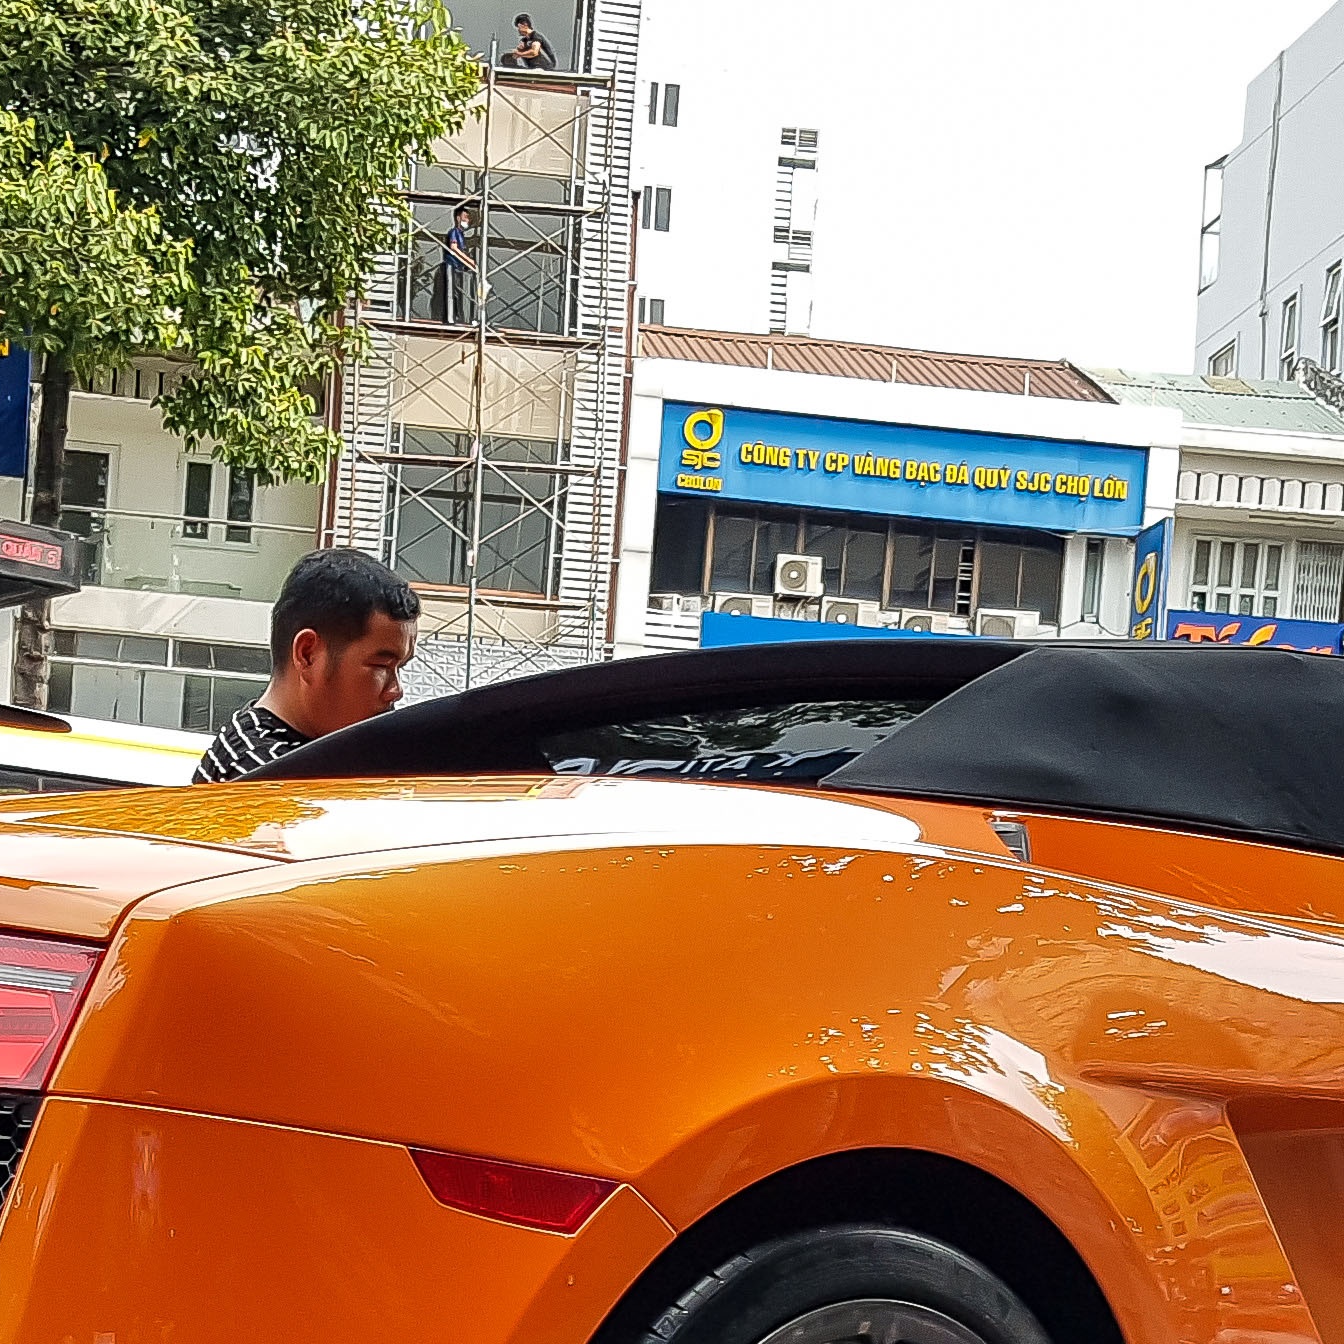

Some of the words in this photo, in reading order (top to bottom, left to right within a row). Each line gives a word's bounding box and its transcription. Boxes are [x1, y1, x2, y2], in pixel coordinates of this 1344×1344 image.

[740, 440, 792, 467] CÔNG
[796, 449, 820, 471] TY
[825, 452, 849, 472] CP
[854, 451, 902, 479] VÀNG
[905, 459, 942, 487] BẠC
[945, 460, 970, 485] ĐÁ
[974, 465, 1011, 489] QUÝ
[1016, 470, 1053, 492] SJC
[1055, 473, 1092, 501] CHỢ
